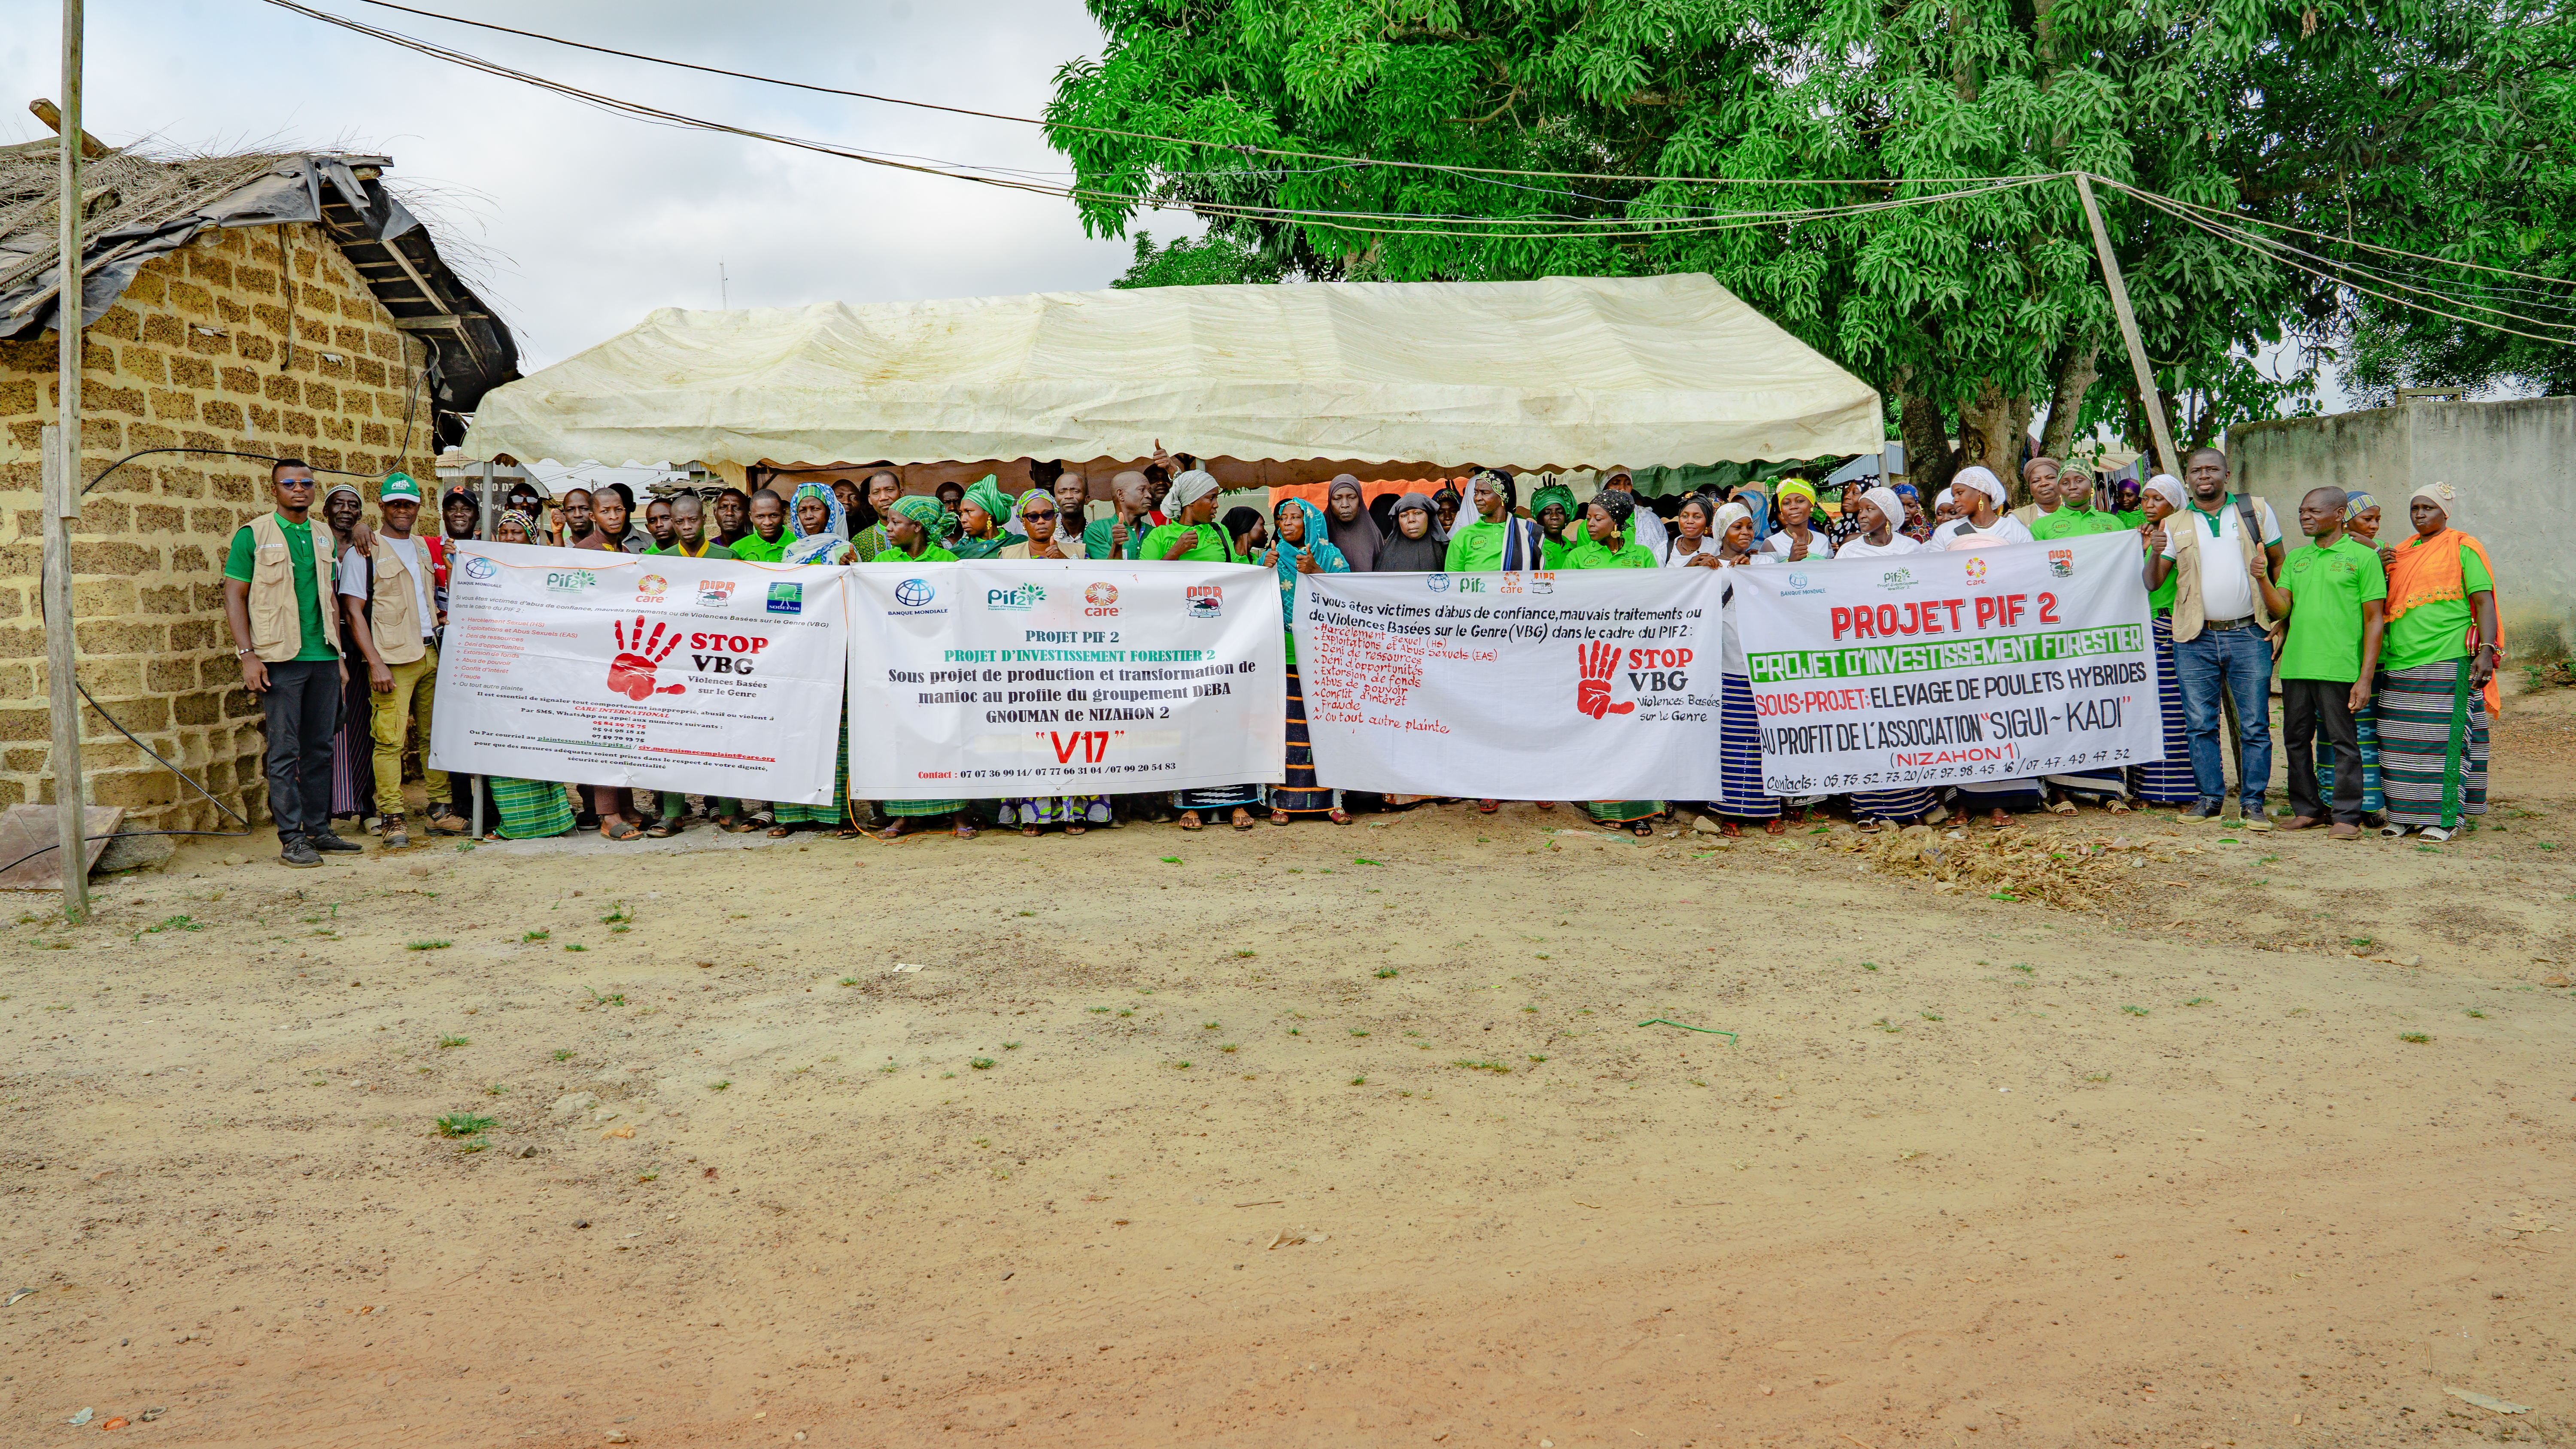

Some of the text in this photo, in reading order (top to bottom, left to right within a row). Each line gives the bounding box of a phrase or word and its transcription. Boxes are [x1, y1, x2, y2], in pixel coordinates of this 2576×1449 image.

[1084, 608, 1118, 616] care
[1311, 592, 1319, 604] Si
[1322, 597, 1346, 608] vous
[1349, 601, 1373, 614] êtes
[1376, 604, 1430, 617] victimes
[1435, 605, 1471, 618] d'abus
[1474, 606, 1490, 618] de
[1614, 607, 1682, 620] traitements
[1686, 609, 1701, 618] ou
[1309, 609, 1324, 621] de
[1327, 612, 1385, 630] Violences
[1387, 621, 1430, 635] Basées
[1434, 627, 1453, 636] sur
[1456, 624, 1467, 637] le
[1552, 626, 1581, 638] dans
[1584, 627, 1596, 639] le
[1599, 626, 1634, 638] cadre
[1639, 626, 1656, 638] du
[1831, 592, 2060, 641] PROJET PIF 2
[691, 633, 768, 654] STOP
[1026, 631, 1119, 644] PROJET PIF 2
[945, 650, 1215, 663] PROJET D'INVESTISSEMENT FORESTIER 2
[1629, 649, 1693, 670] STOP
[1752, 625, 2144, 681] PROJET D'INVESTISSEMENT FORESTIER
[692, 655, 754, 675] VBG
[889, 661, 1255, 684] Sous projet de production et transformation de
[688, 676, 767, 688] Violences Basées
[1628, 671, 1688, 691] VBG
[1956, 678, 1981, 700] DE
[1984, 671, 2064, 698] POULETS
[2067, 662, 2146, 688] HYBRIDES
[919, 682, 1231, 703] manioc au profile du groupement DEBA
[1637, 694, 1720, 707] Violences Basées
[599, 707, 669, 718] INTERNATIONAL
[986, 707, 1169, 723] GNOUMAN de NIZAHON 2
[1660, 711, 1669, 721] le
[1672, 711, 1707, 722] Genre
[1760, 728, 1775, 755] AU
[1777, 724, 1833, 755] PROFIT
[1836, 723, 1860, 751] DE
